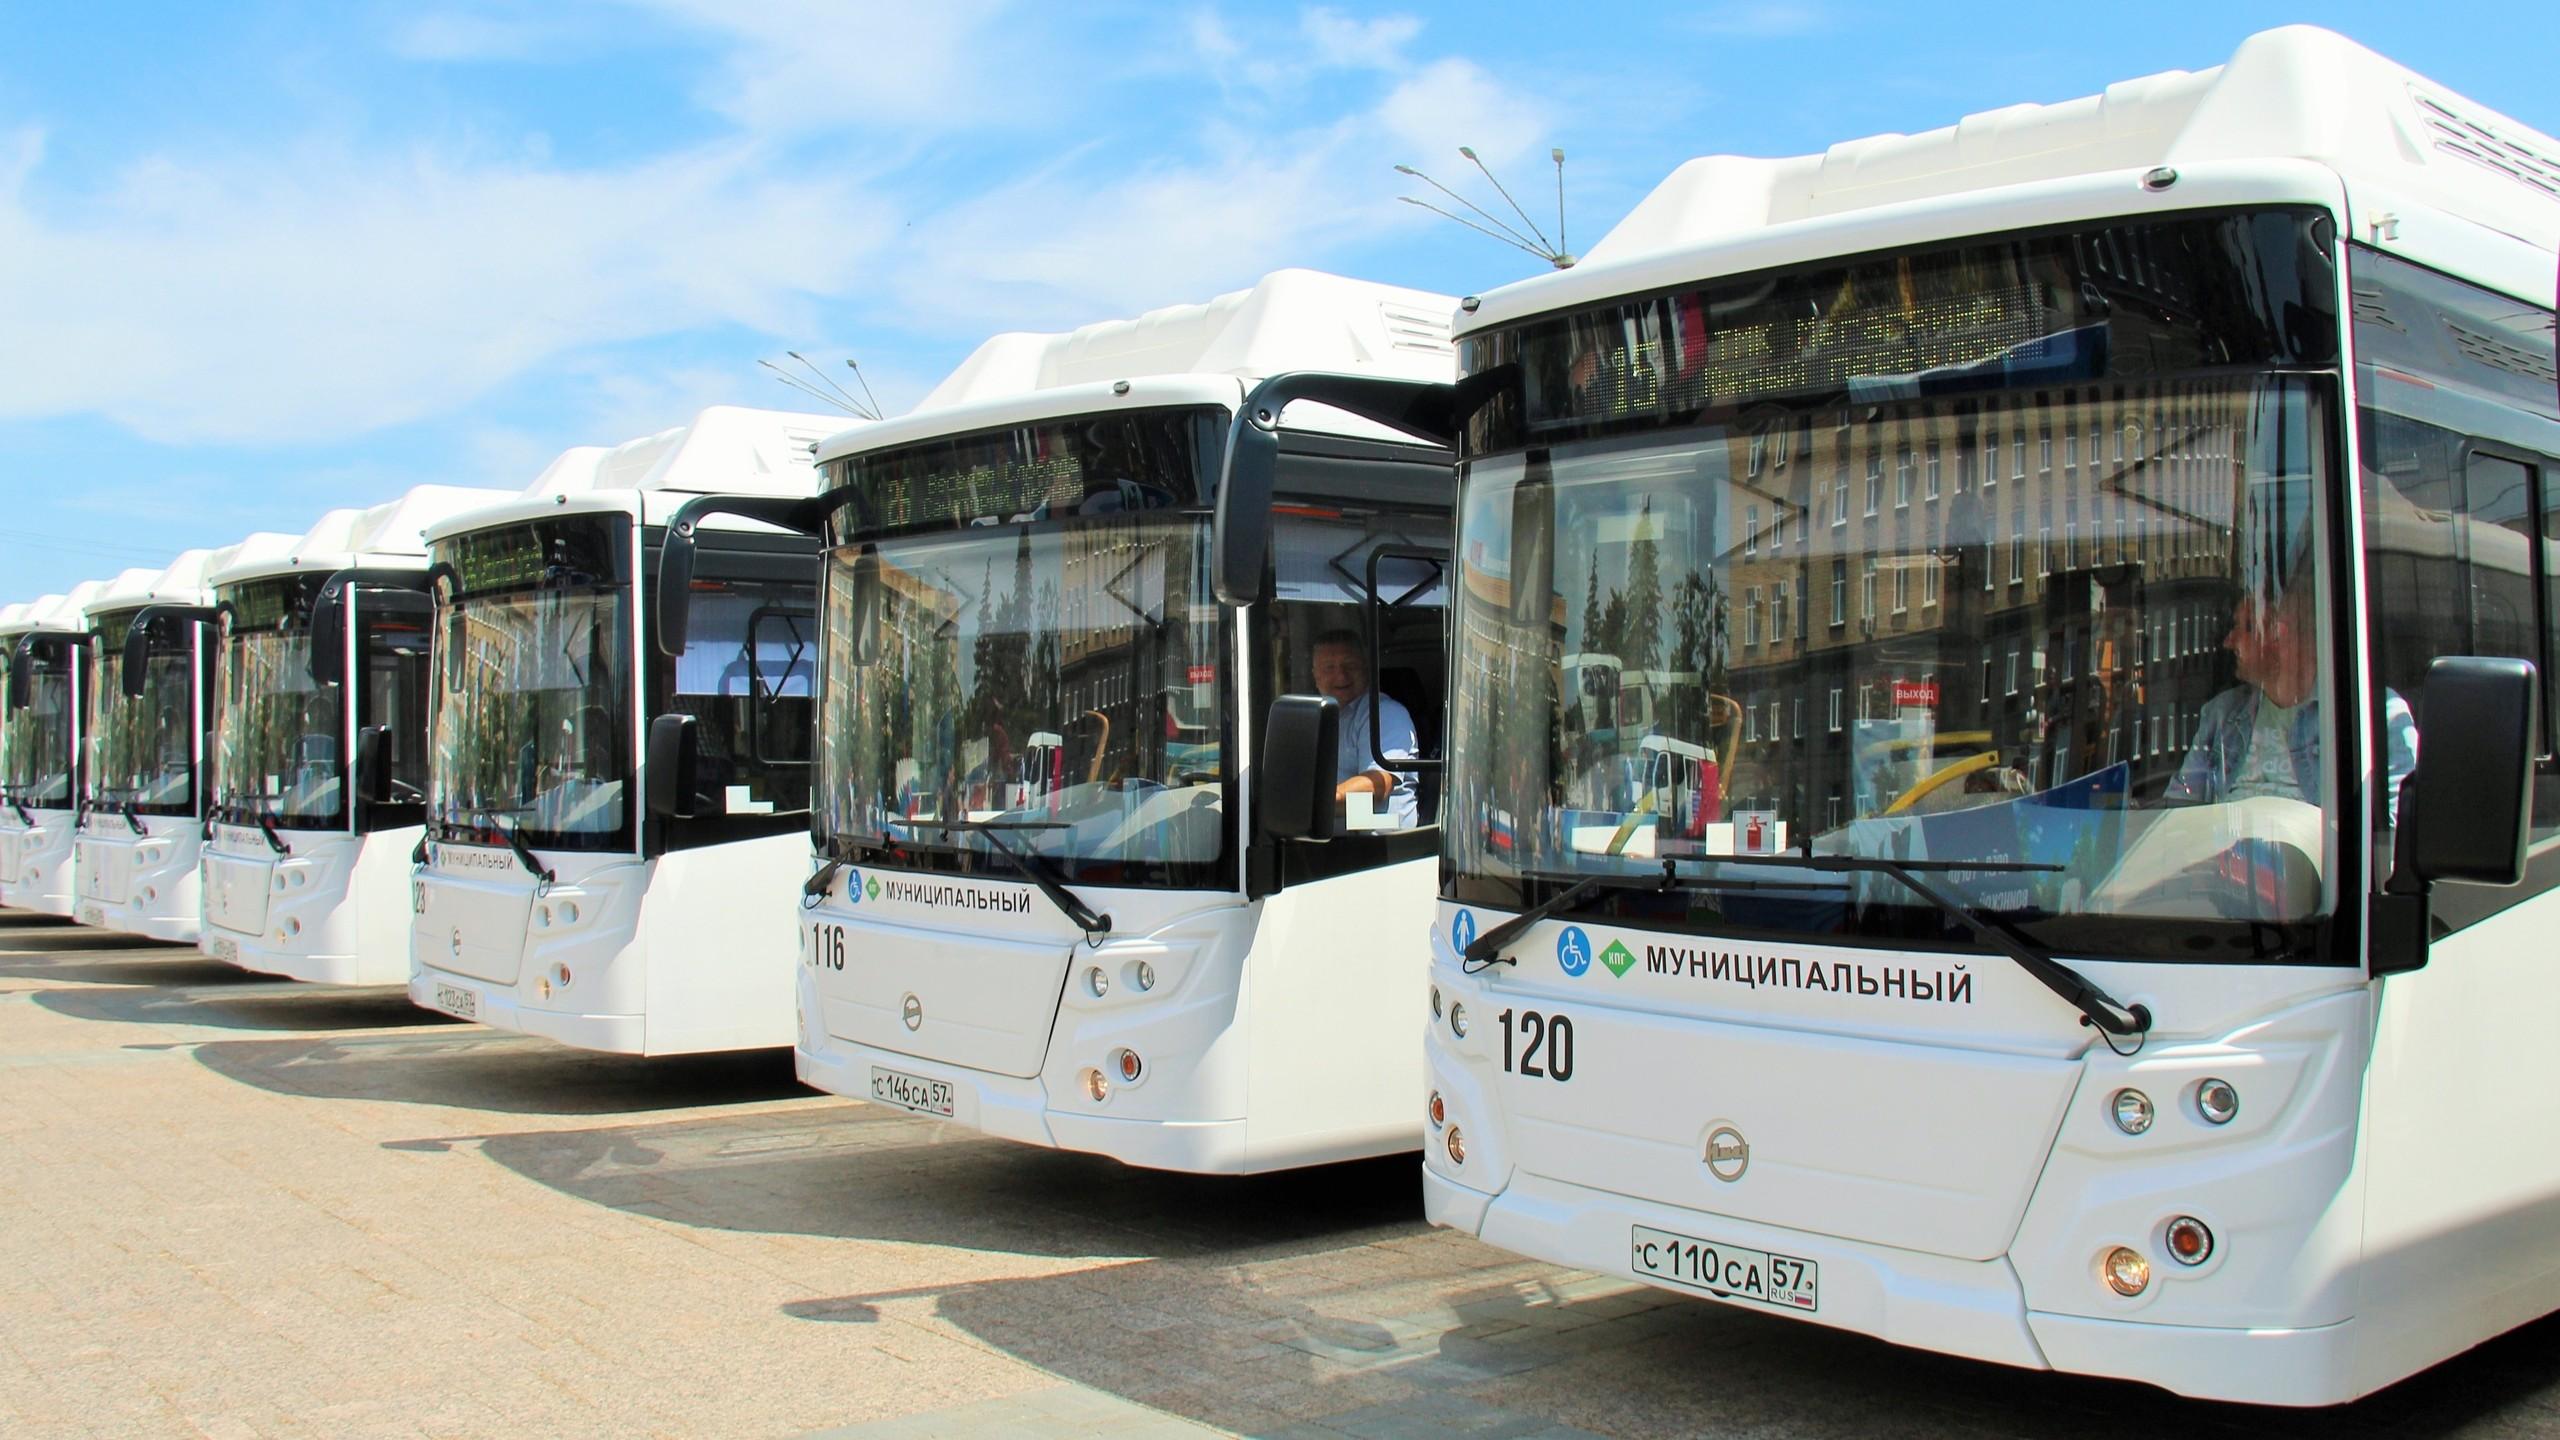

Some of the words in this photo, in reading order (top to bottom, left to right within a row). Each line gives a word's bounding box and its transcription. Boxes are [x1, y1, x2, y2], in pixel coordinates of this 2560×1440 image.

[1714, 321, 1774, 362] ТМК
[1612, 341, 1657, 415] 15
[1896, 689, 1935, 700] ВЫХОД
[886, 881, 1031, 914] МУНИЦИПАЛЬНЫЙ
[813, 922, 845, 971] 116
[1608, 952, 1625, 966] КПГ
[1646, 945, 1972, 1003] МУНИЦИПАЛЬНЫЙ
[1499, 1008, 1574, 1082] 120
[932, 1083, 947, 1104] 57
[1772, 1258, 1804, 1290] 57
[1770, 1287, 1794, 1302] RUS
